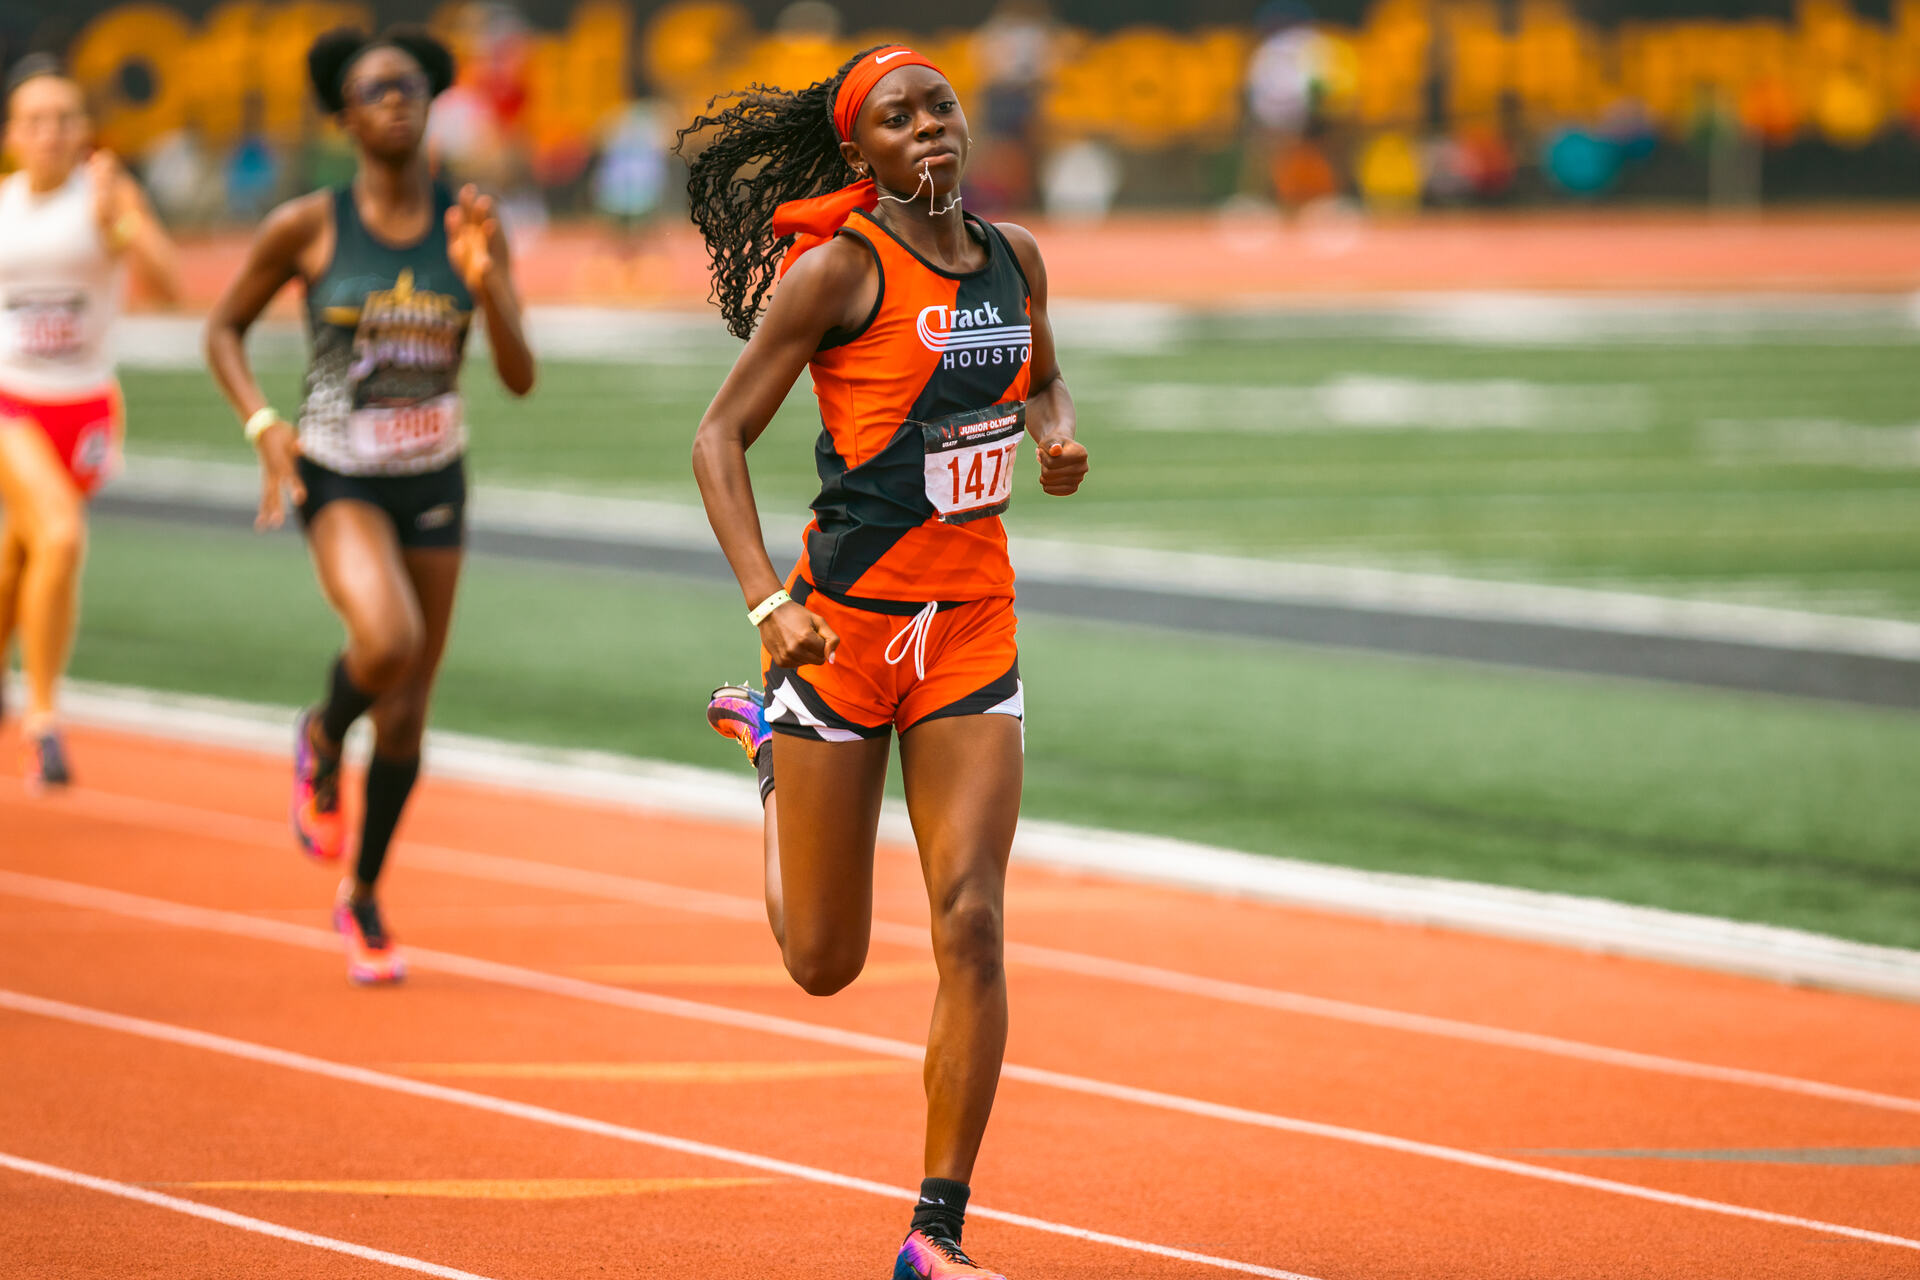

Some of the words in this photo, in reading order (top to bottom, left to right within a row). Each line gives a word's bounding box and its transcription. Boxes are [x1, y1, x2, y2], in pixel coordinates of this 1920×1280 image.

[917, 301, 1003, 330] Track
[960, 422, 988, 436] JUNIOR
[989, 414, 1017, 428] OLYMPIC
